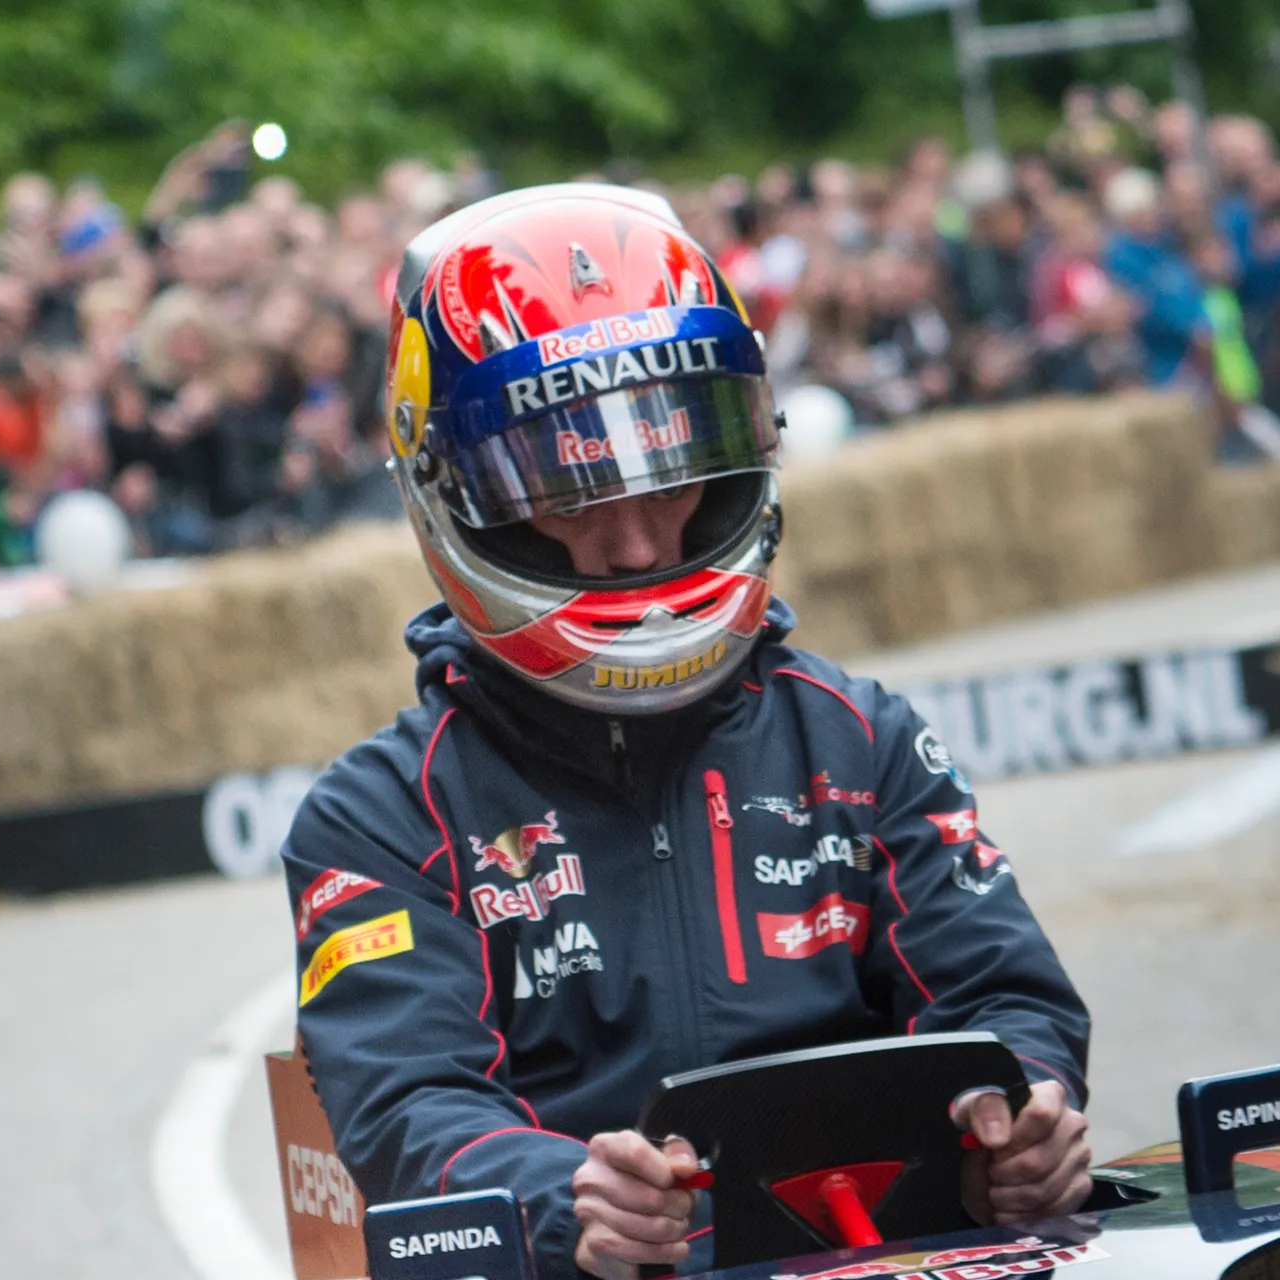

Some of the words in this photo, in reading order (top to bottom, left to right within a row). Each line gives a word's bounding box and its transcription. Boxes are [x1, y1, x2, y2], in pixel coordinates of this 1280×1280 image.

[539, 321, 609, 366] Red
[610, 308, 675, 349] Bull
[505, 337, 720, 416] RENAULT
[592, 641, 727, 690] JUMBO
[912, 646, 1272, 784] URG.NL
[312, 871, 371, 909] CEPS
[307, 924, 398, 993] PIRELLI
[533, 922, 599, 976] NVA
[287, 1143, 358, 1228] CEPSA
[388, 1225, 502, 1260] SAPINDA
